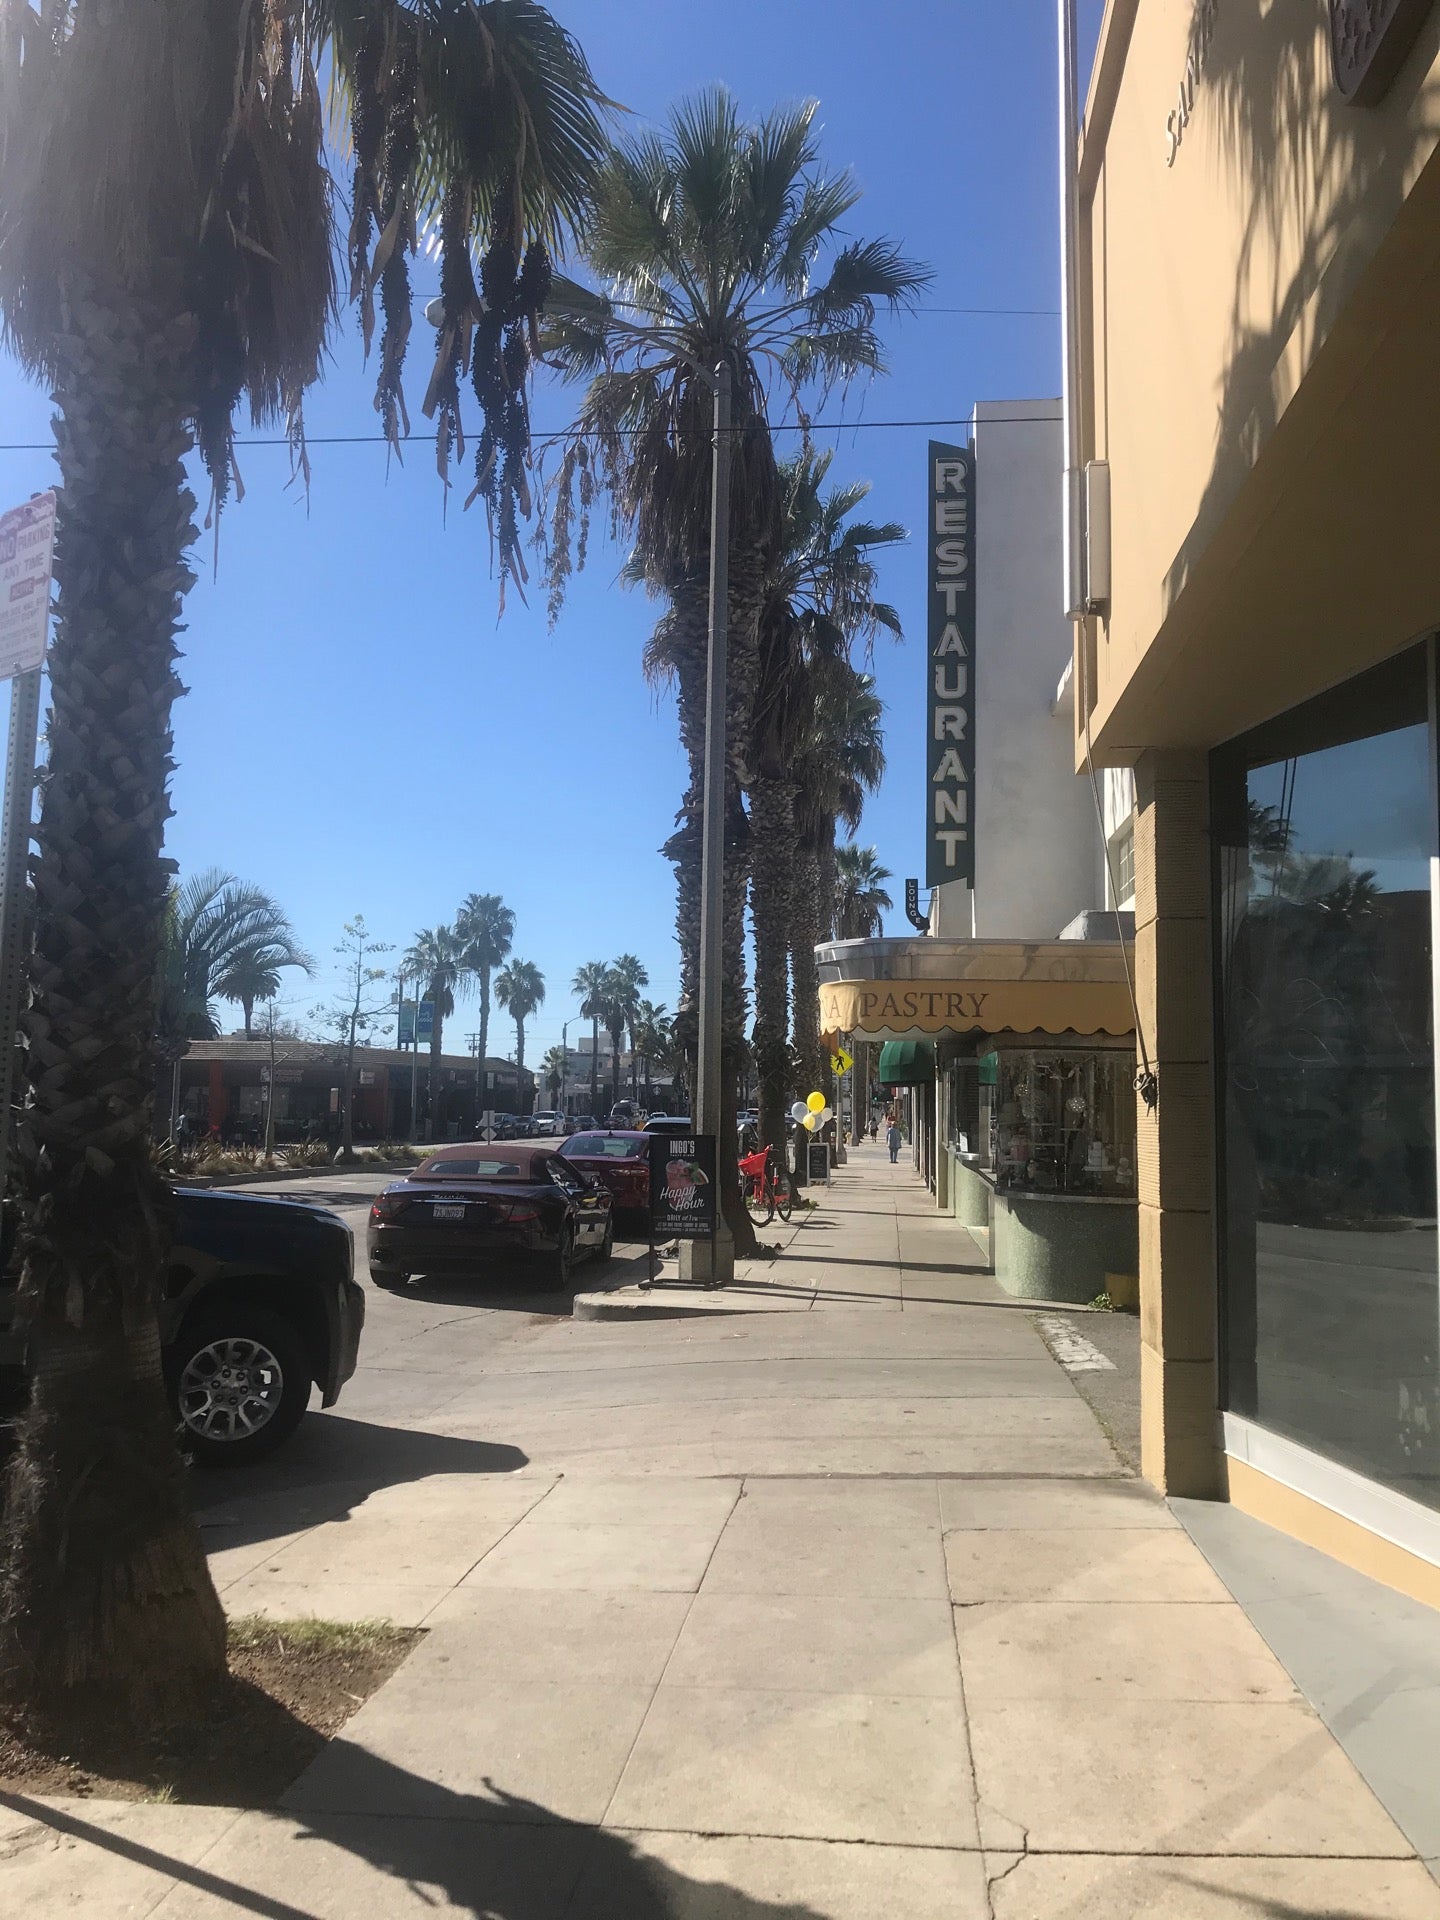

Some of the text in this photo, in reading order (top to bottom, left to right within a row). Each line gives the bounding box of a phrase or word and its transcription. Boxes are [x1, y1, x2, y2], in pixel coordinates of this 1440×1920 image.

[933, 457, 968, 868] RESTAURANT
[908, 881, 921, 924] LOUNGE
[861, 992, 990, 1018] PASTRY
[670, 1140, 695, 1154] INGO'S
[660, 1185, 697, 1201] Happy
[675, 1198, 704, 1212] Hour
